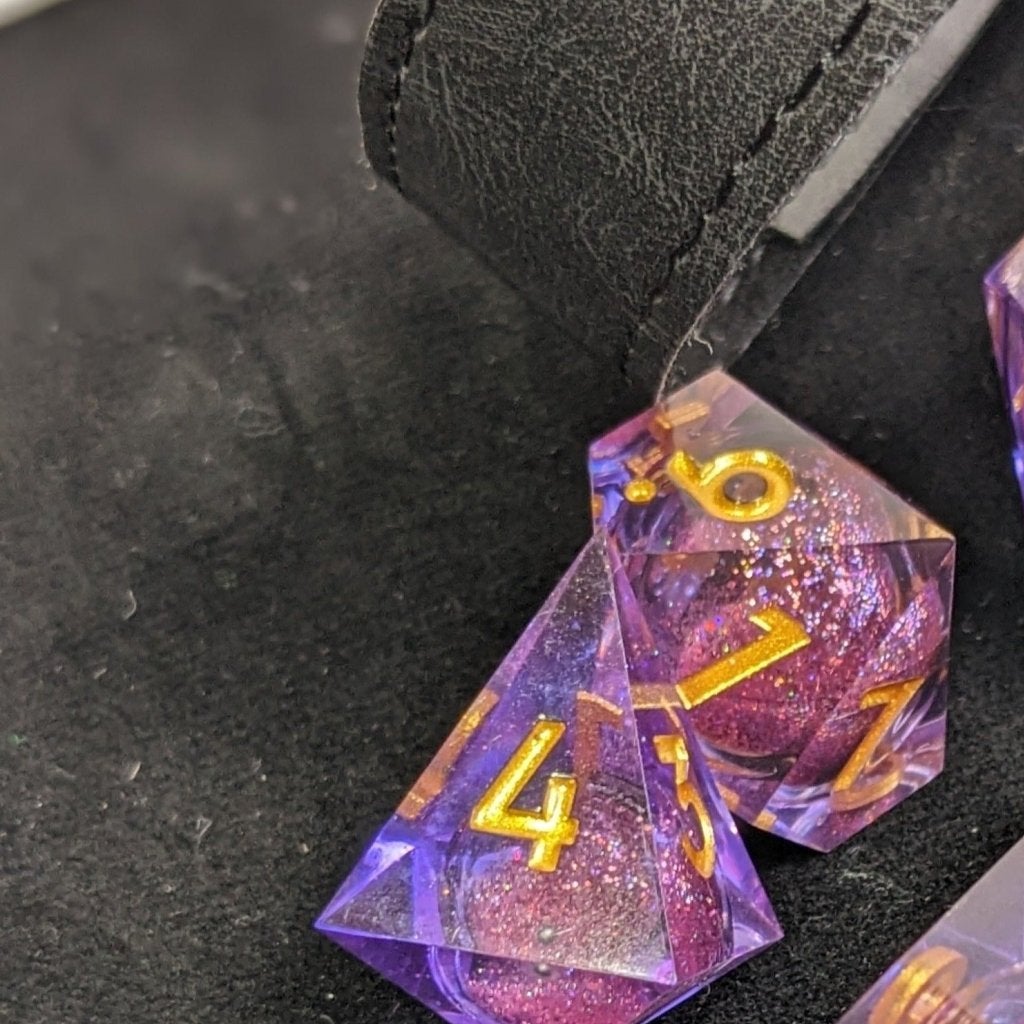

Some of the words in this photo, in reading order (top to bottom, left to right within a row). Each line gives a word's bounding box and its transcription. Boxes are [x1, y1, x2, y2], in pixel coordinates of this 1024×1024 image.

[676, 606, 812, 711] 1
[469, 717, 580, 873] 4
[653, 733, 715, 880] 3
